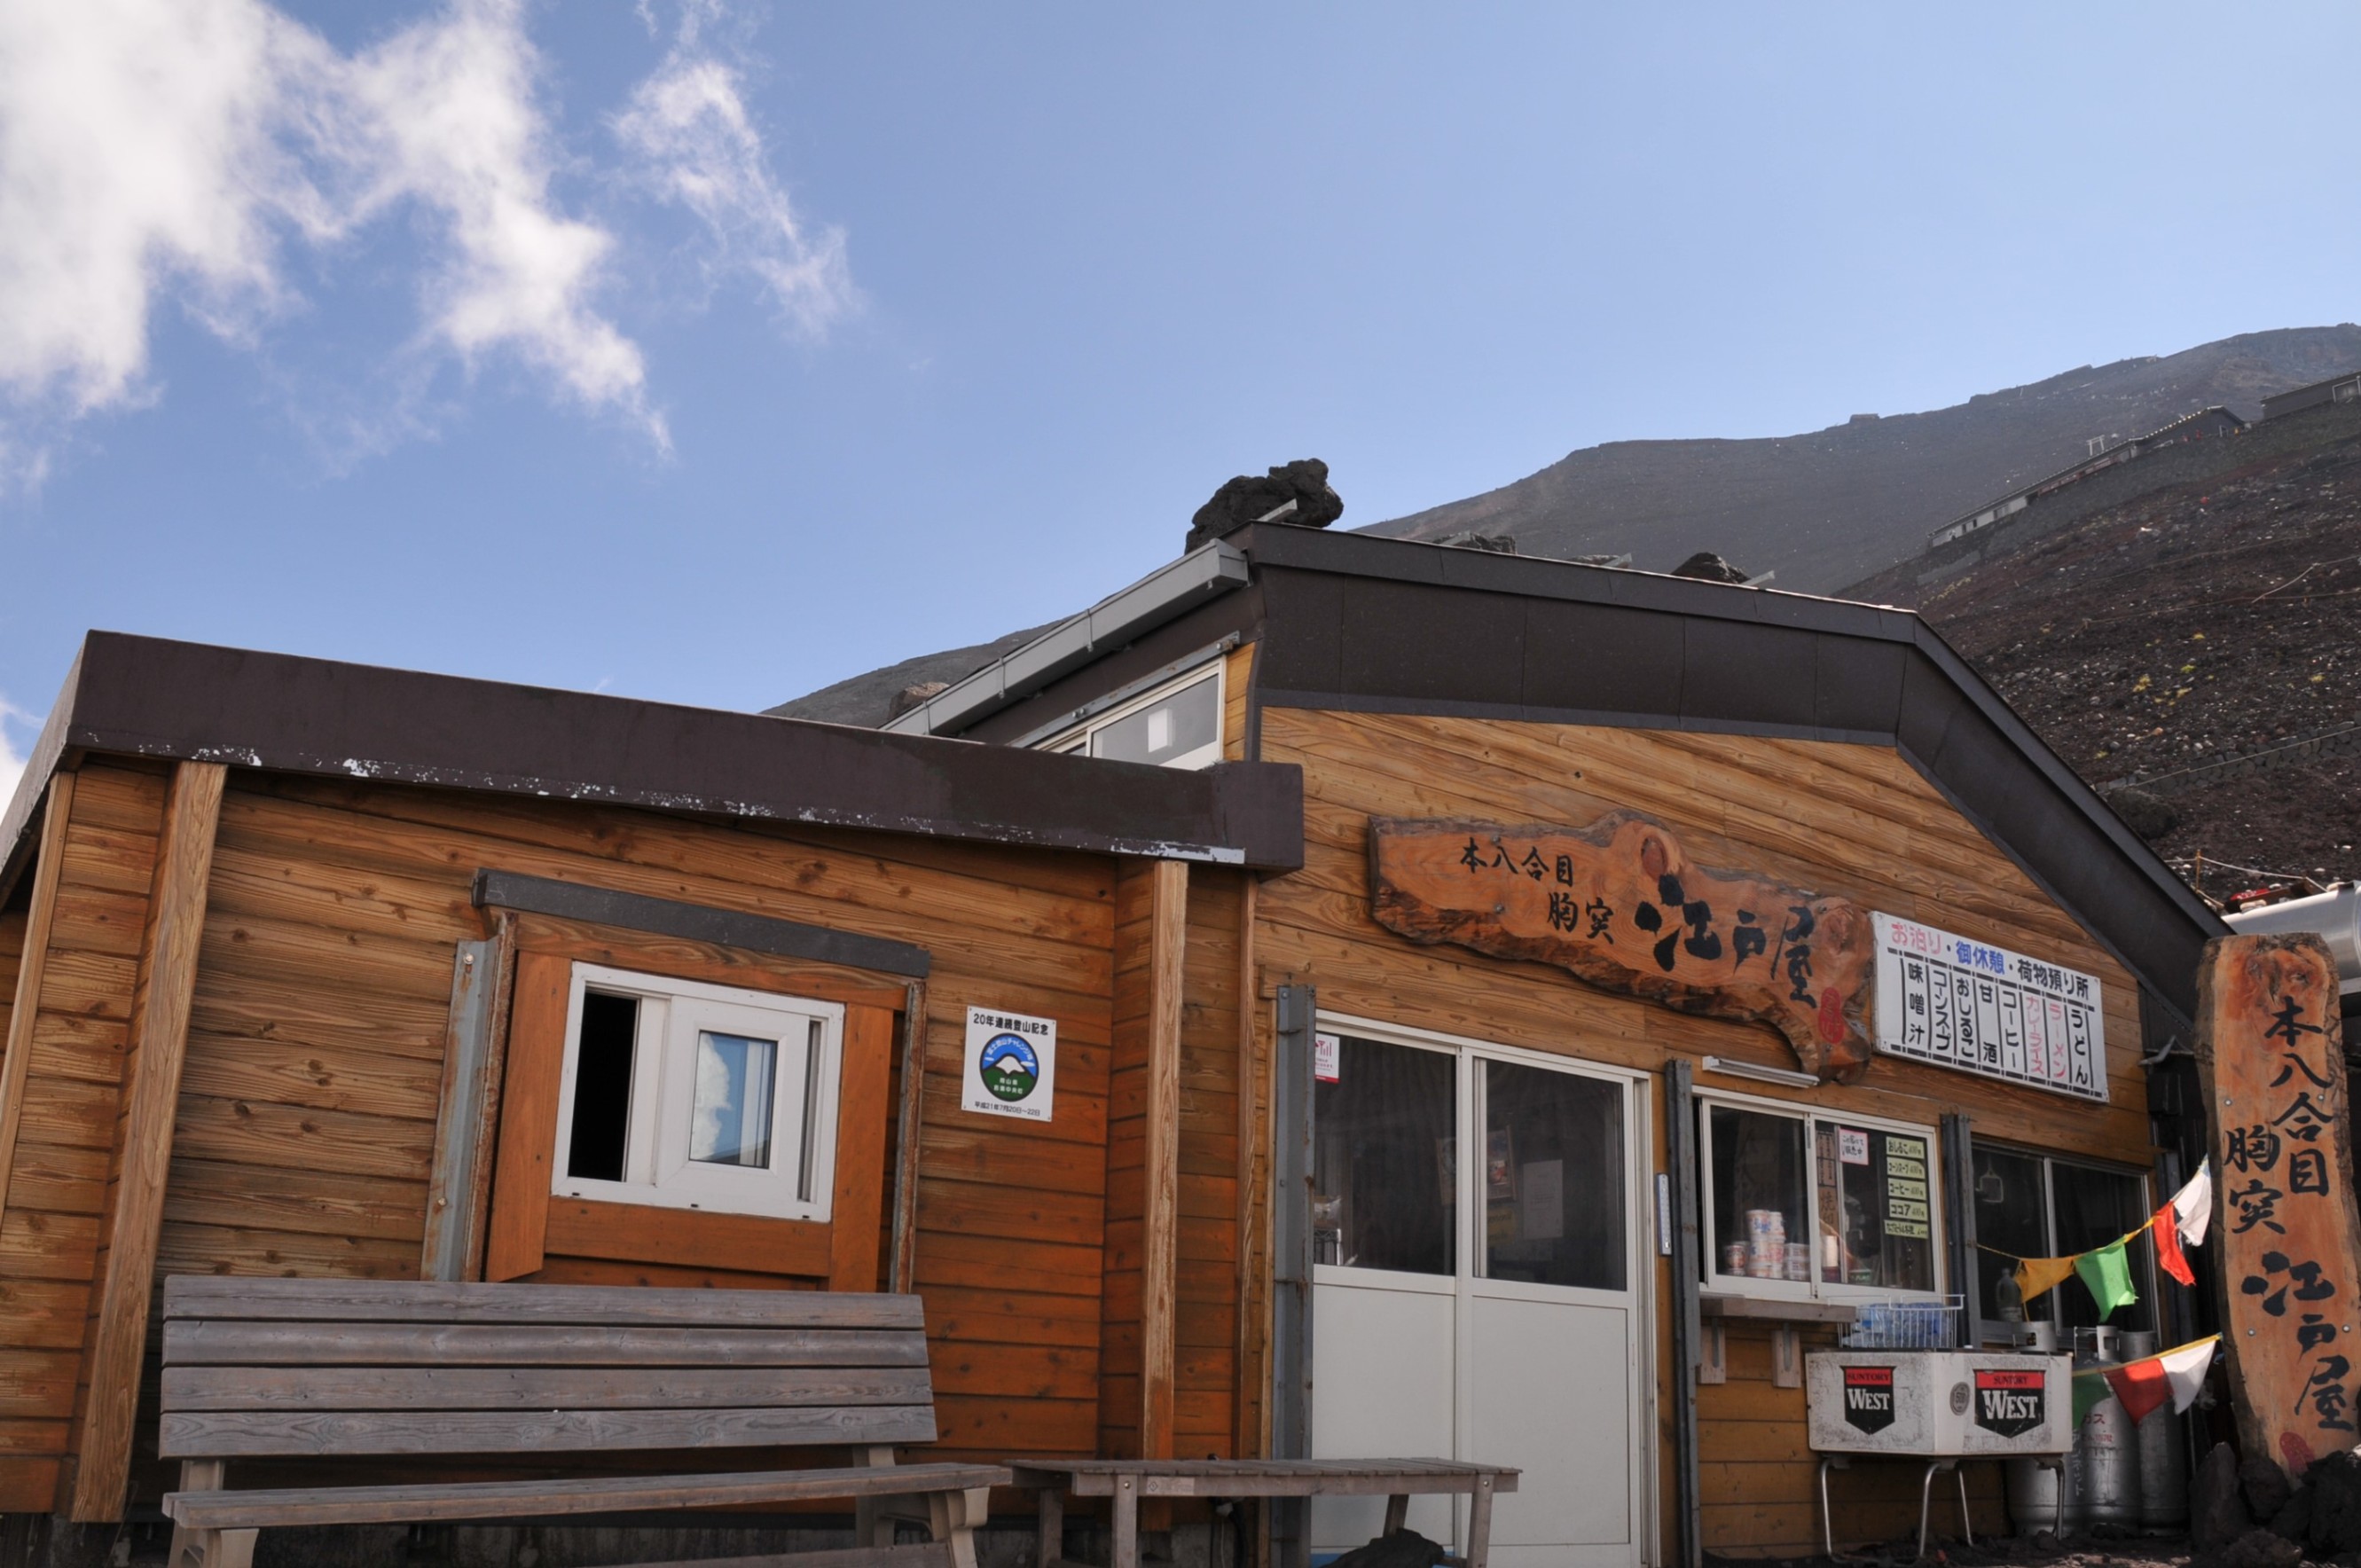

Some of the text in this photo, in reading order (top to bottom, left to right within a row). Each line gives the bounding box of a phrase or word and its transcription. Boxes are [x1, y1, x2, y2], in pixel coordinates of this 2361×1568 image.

[1460, 836, 1573, 888] 本八合目
[1548, 891, 1614, 945] 胸突
[1634, 874, 1817, 1009] 江戸屋
[973, 1013, 1049, 1036] 20年連続登山記念
[1908, 962, 1925, 1045] 味噌汁
[1933, 969, 1951, 1051] コーンスープ
[1957, 977, 1974, 1058] おしるこ
[1979, 984, 1997, 1063] 甘酒
[2002, 991, 2020, 1068] コーヒー
[2026, 996, 2044, 1075] カレーライス
[2049, 1003, 2067, 1078] ラーメン
[2070, 1009, 2089, 1085] うどん
[2264, 996, 2334, 1197] 本八合目
[1891, 1203, 1911, 1216] ココア
[2224, 1124, 2286, 1235] 胸突
[2241, 1250, 2356, 1431] 江戸屋
[1847, 1388, 1890, 1410] WEST
[1982, 1390, 2038, 1419] WEST
